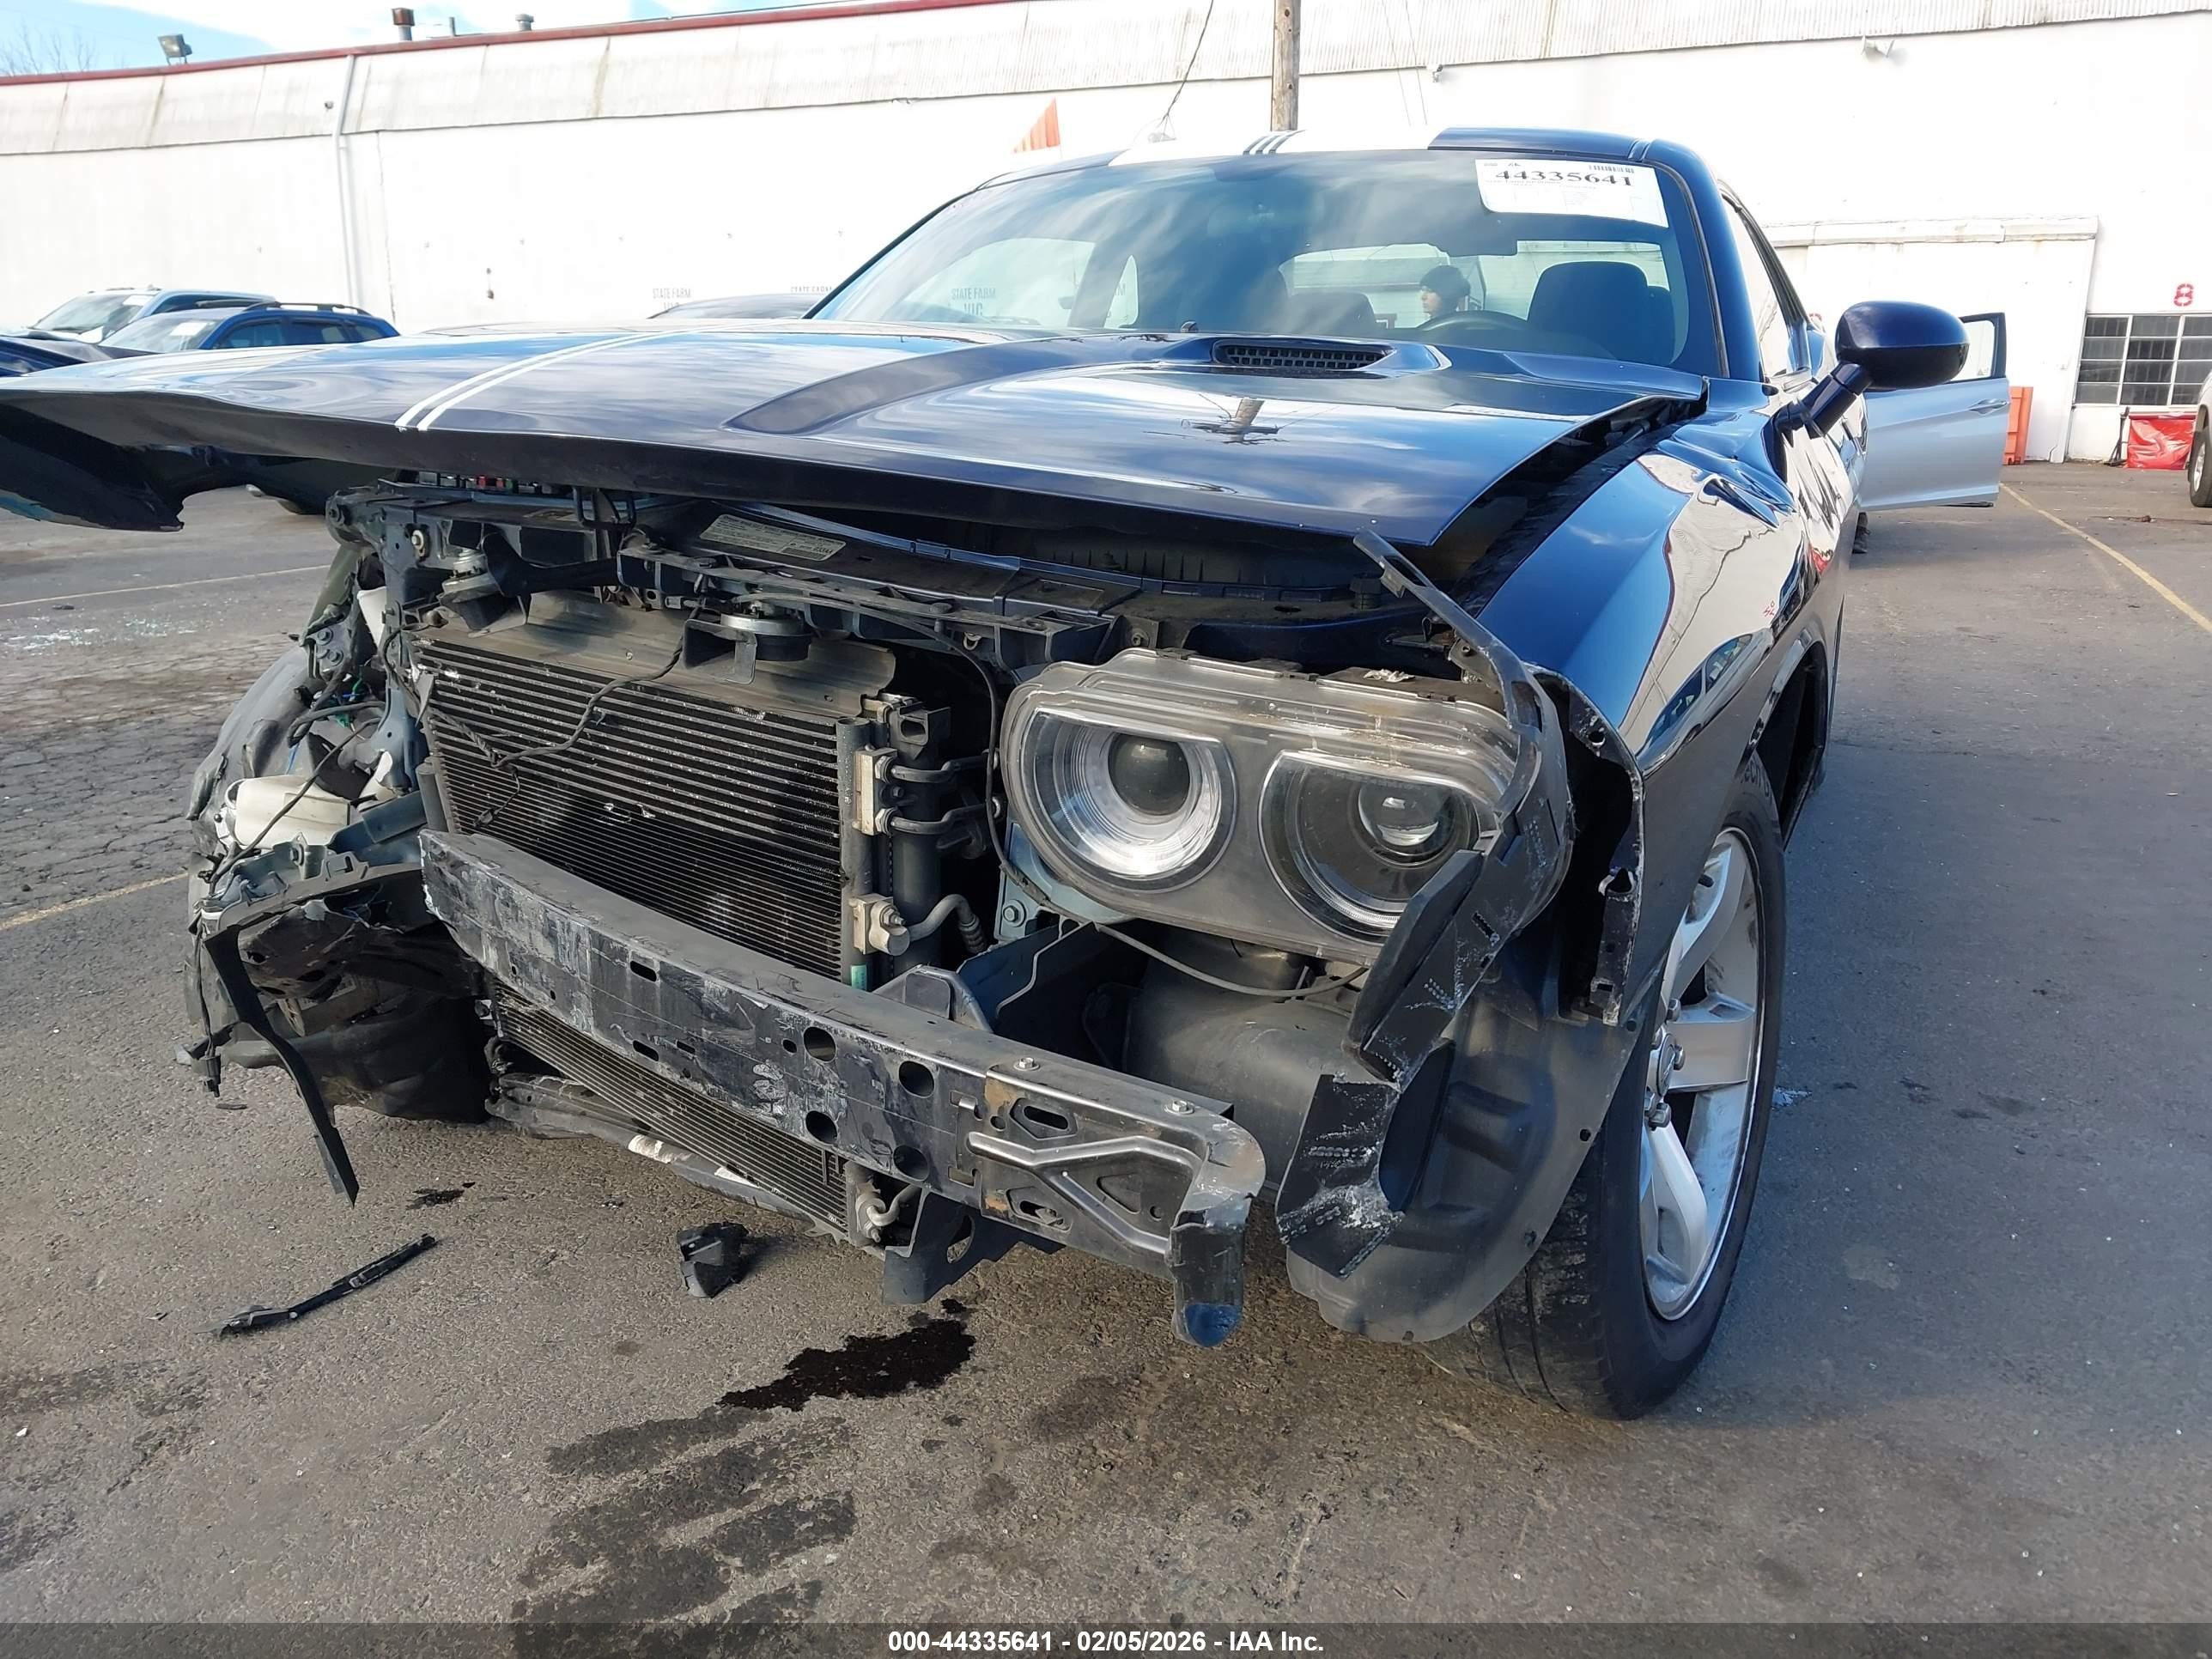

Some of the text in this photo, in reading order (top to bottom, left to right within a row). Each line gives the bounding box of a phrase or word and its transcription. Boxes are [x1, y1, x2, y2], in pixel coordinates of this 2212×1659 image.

[1495, 170, 1632, 186] 44335641
[653, 288, 671, 299] STATE
[951, 288, 996, 300] STATE FARM
[2173, 283, 2194, 307] 8
